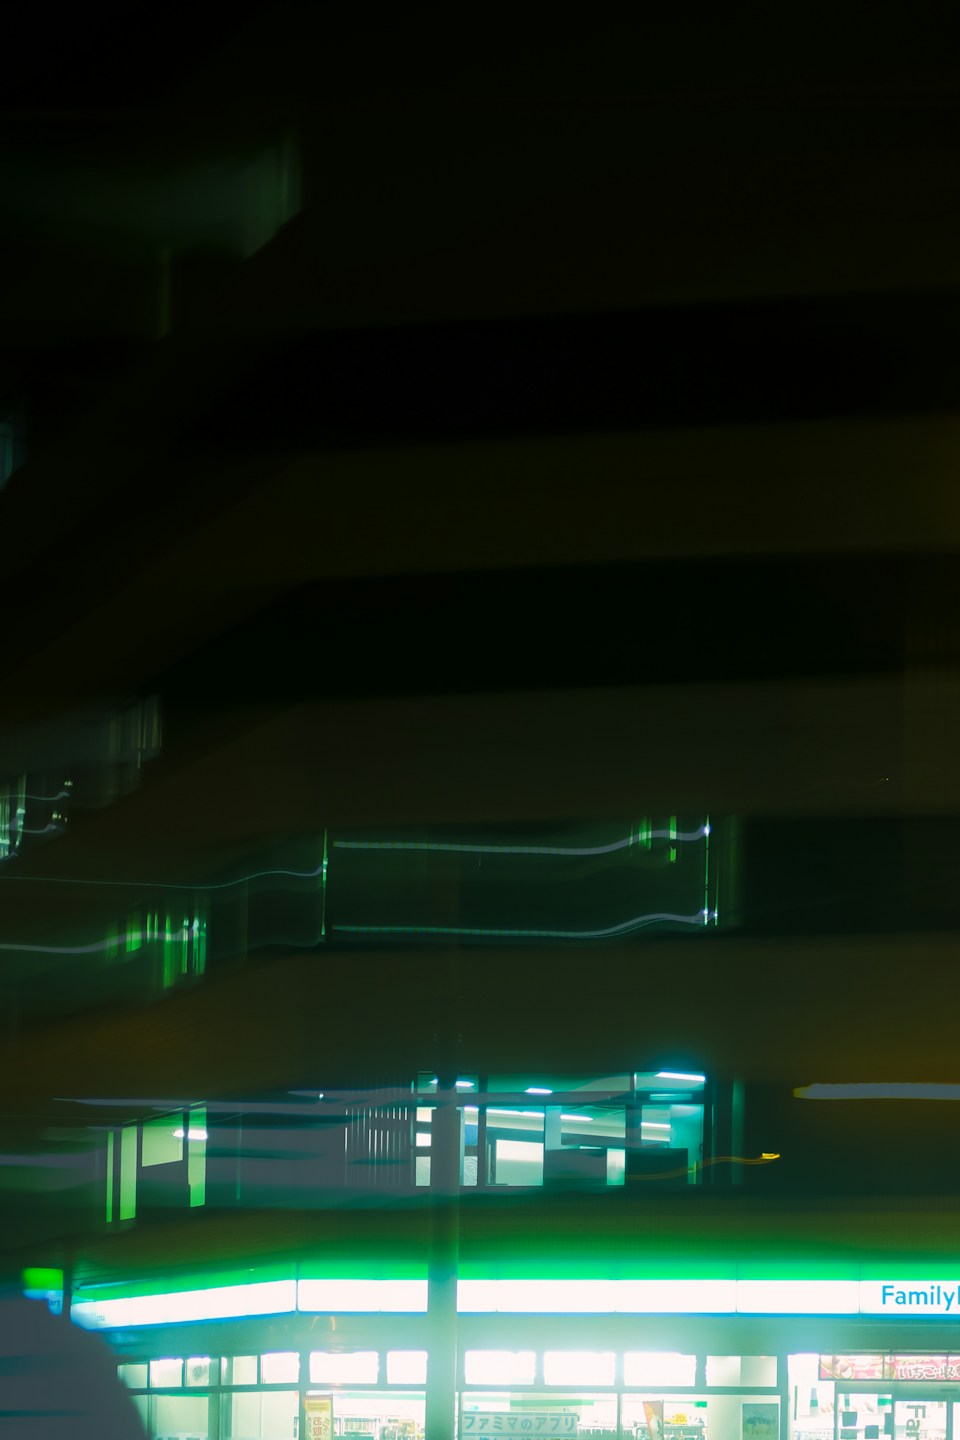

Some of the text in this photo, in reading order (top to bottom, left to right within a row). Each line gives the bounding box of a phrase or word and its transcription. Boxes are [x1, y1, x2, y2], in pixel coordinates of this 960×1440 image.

[464, 1416, 575, 1431] ファミマのアプリ
